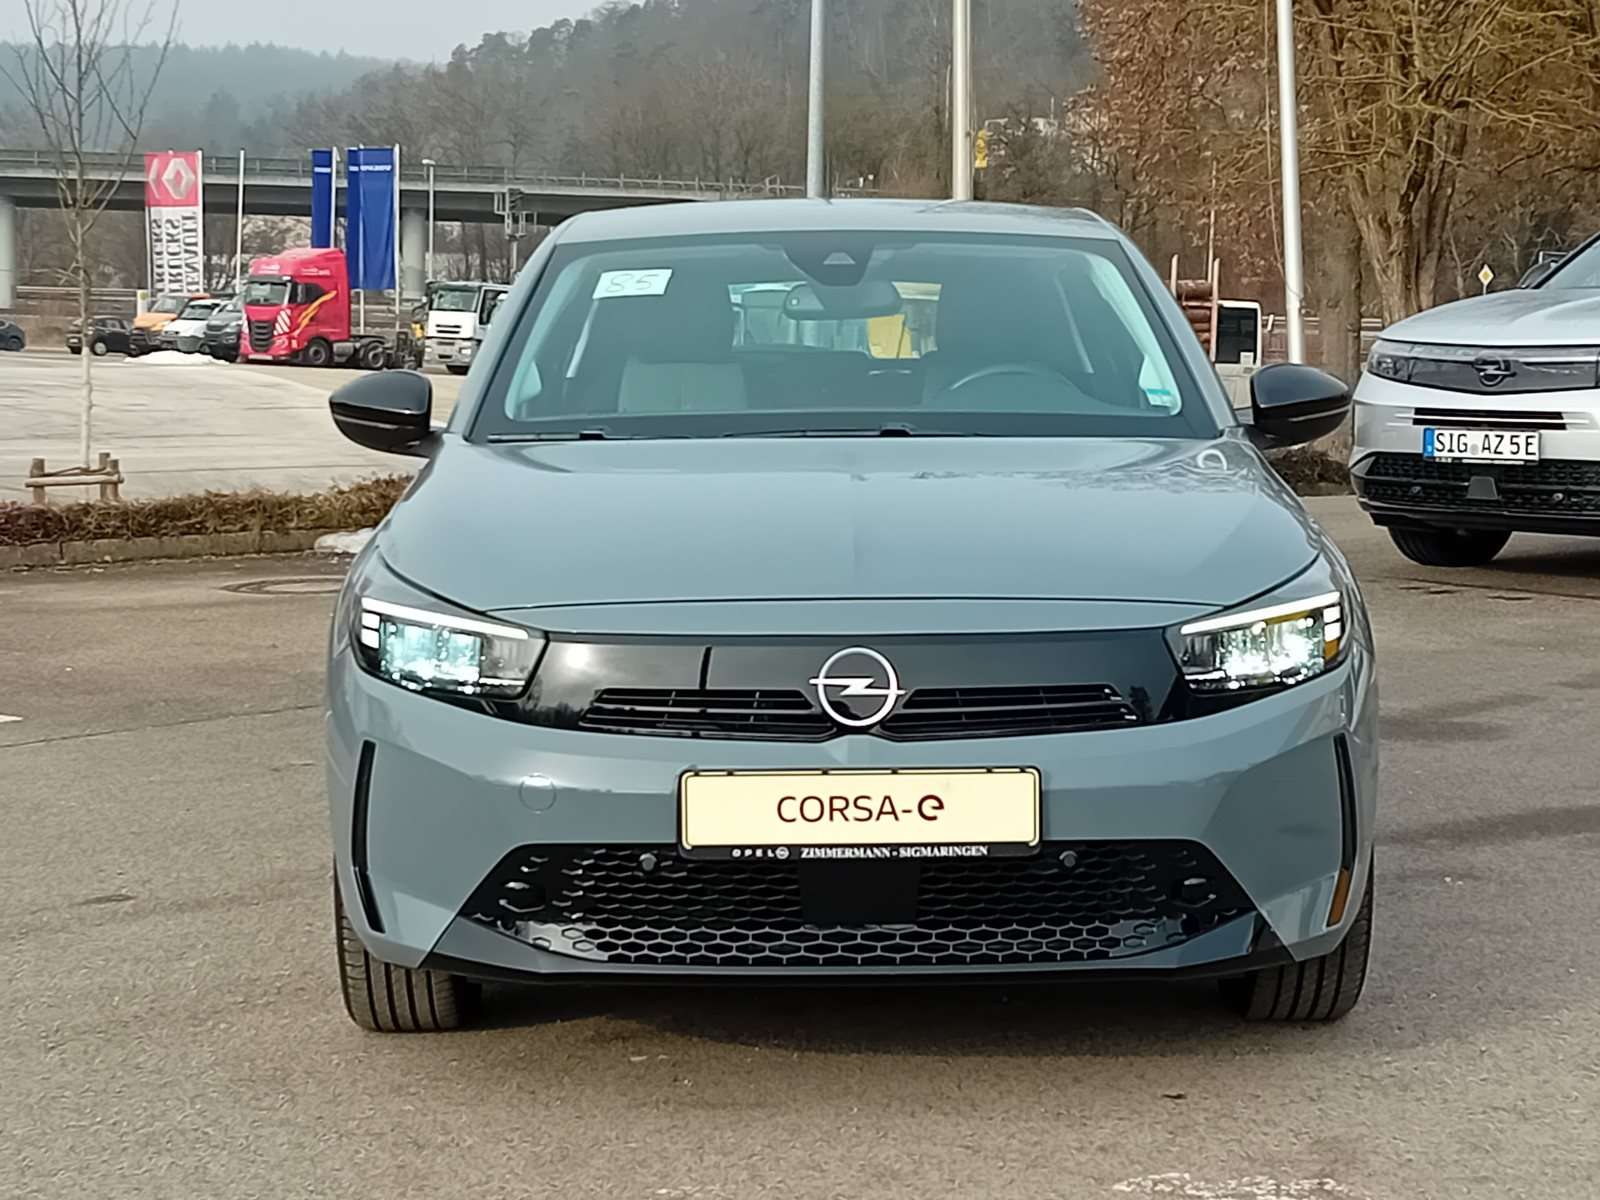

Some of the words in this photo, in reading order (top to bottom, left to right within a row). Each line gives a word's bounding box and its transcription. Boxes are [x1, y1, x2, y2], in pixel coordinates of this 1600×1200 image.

[1435, 433, 1469, 453] SIG
[1481, 435, 1504, 455] AZ
[1509, 436, 1521, 455] 5
[1525, 436, 1537, 455] E
[776, 794, 945, 823] CORSA-e
[731, 848, 775, 858] OPEL
